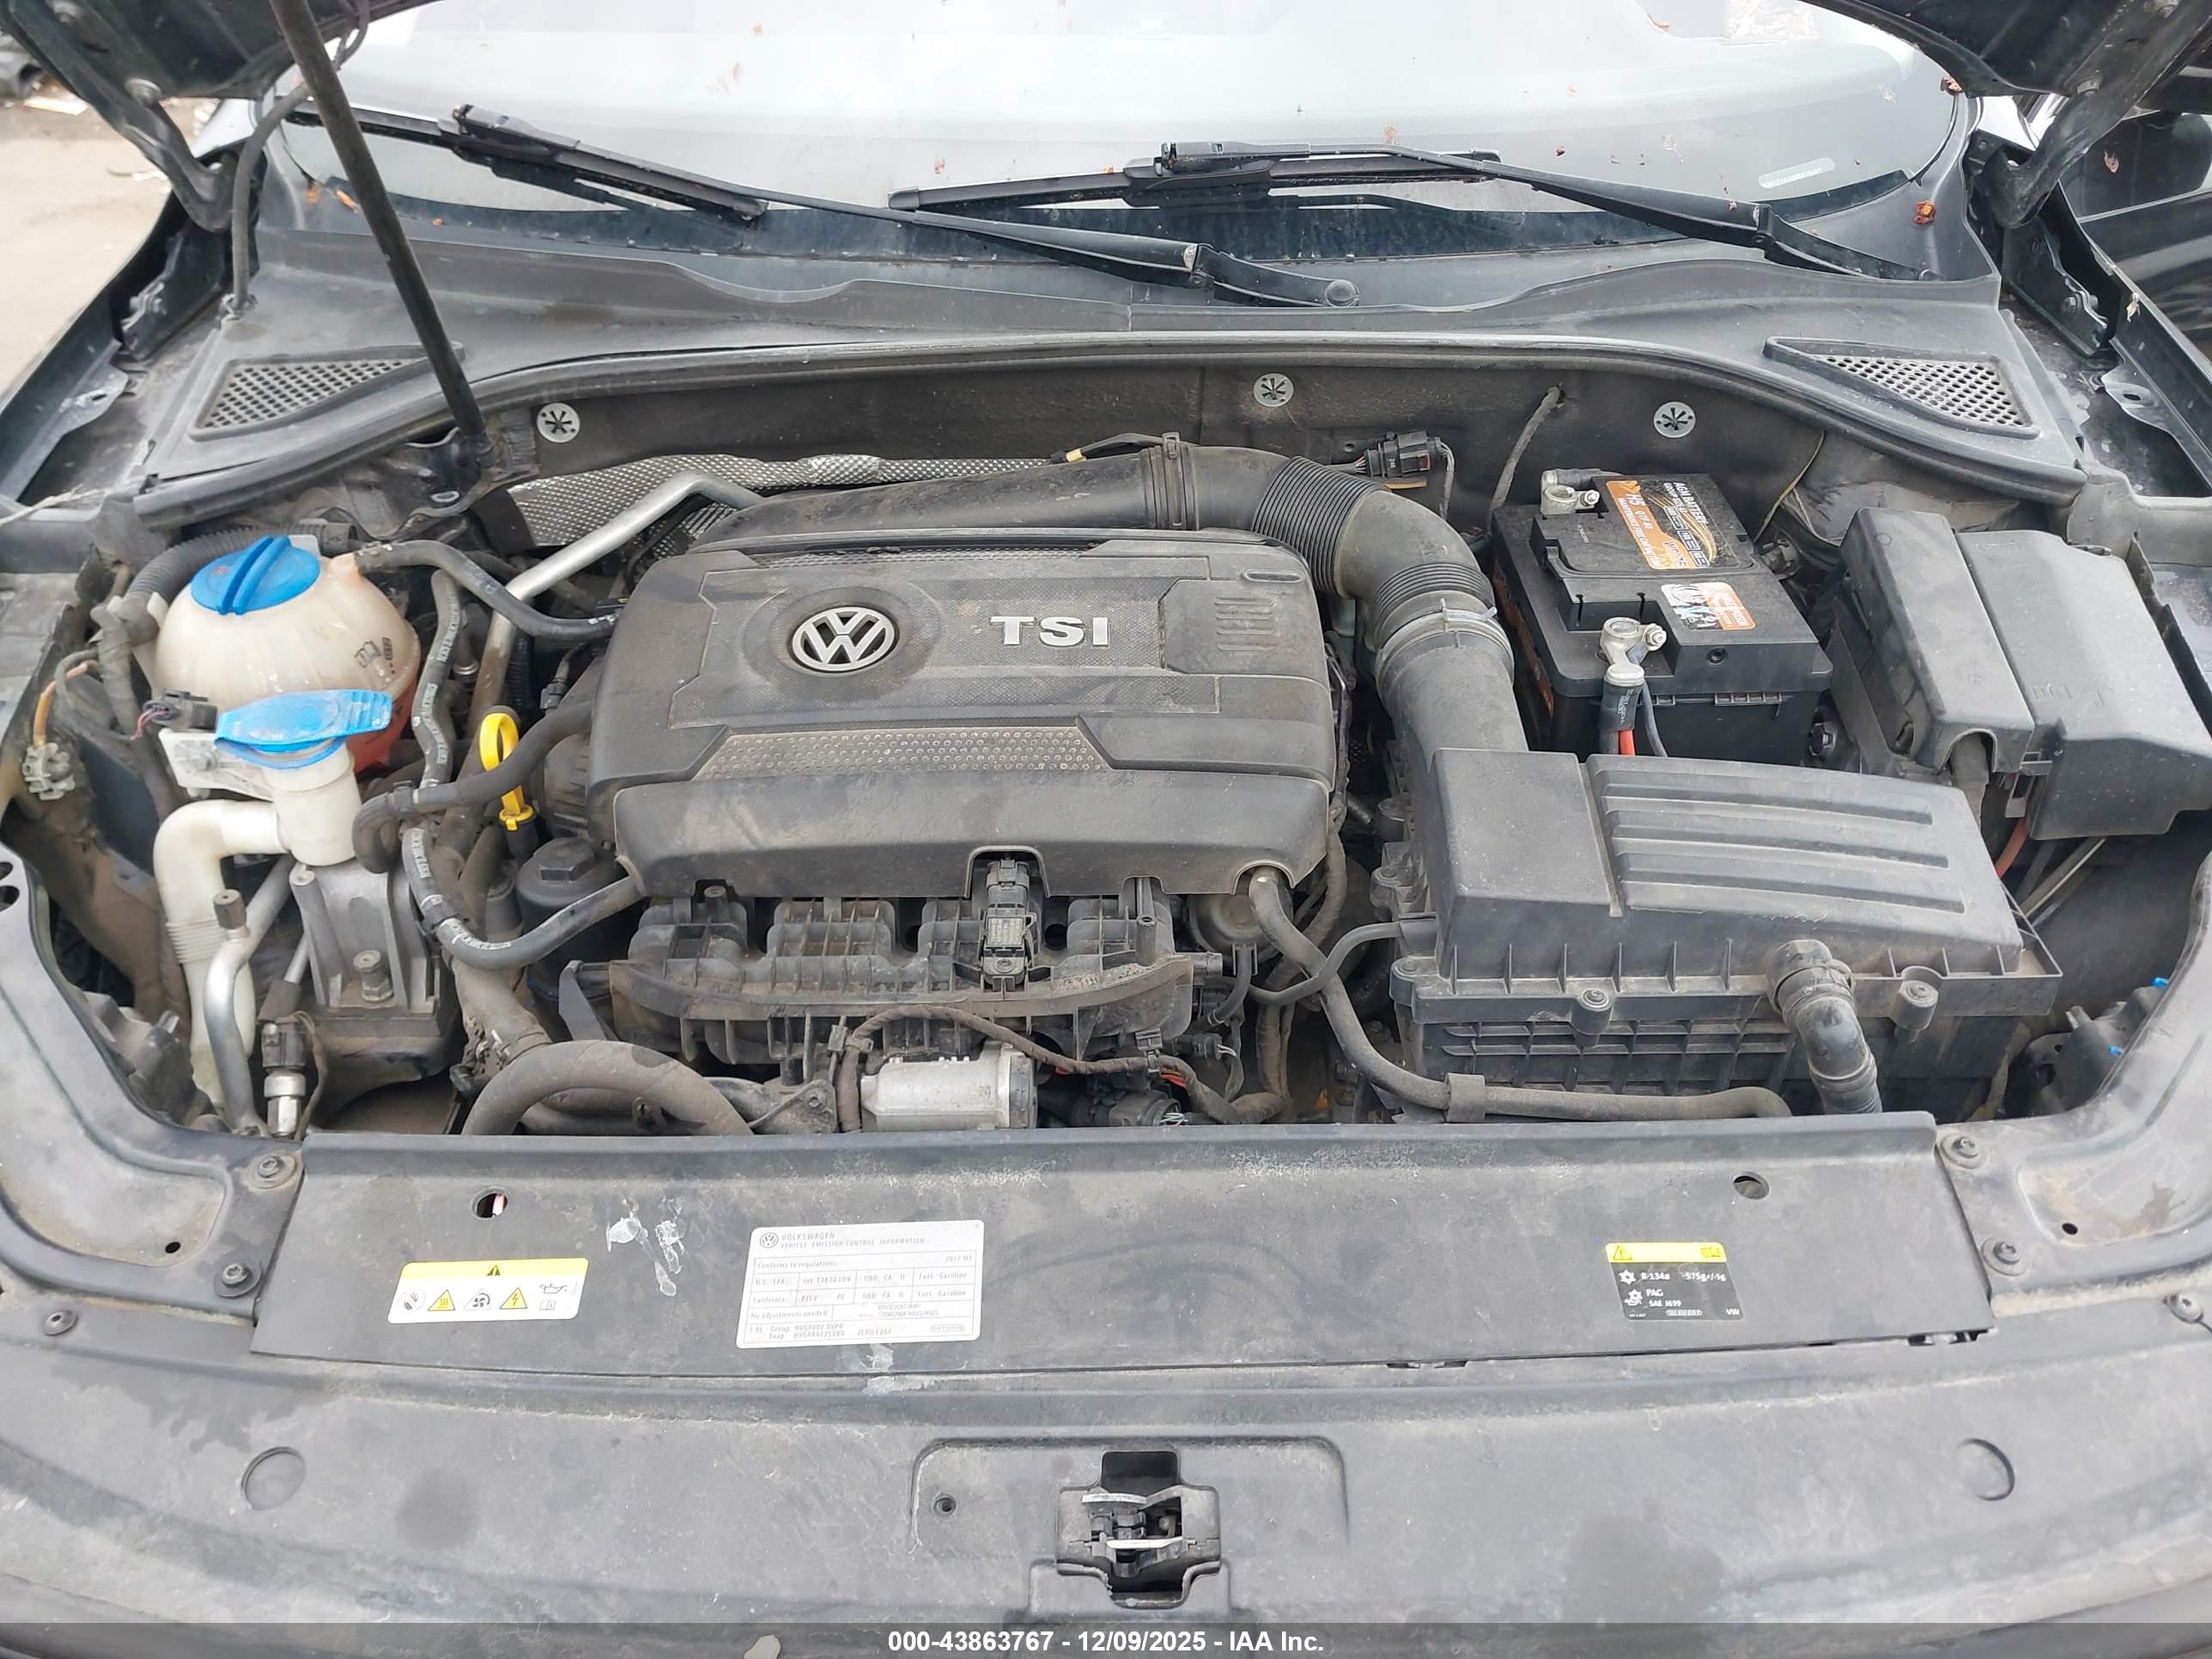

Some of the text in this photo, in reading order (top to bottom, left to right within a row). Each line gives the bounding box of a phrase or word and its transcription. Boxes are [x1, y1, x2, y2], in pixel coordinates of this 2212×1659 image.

[1674, 482, 1691, 496] AGM
[1626, 494, 1646, 506] H5
[1682, 497, 1709, 524] BATTERY
[989, 615, 1109, 647] TSI
[781, 1231, 836, 1241] VOLKSWAGEN
[811, 1240, 844, 1249] EMISSION
[878, 1237, 926, 1245] INFORMATION
[757, 1261, 788, 1270] Conforms
[1645, 1288, 1665, 1297] PAG
[750, 1311, 760, 1320] No
[803, 1310, 828, 1318] needed
[1725, 1308, 1741, 1316] VW
